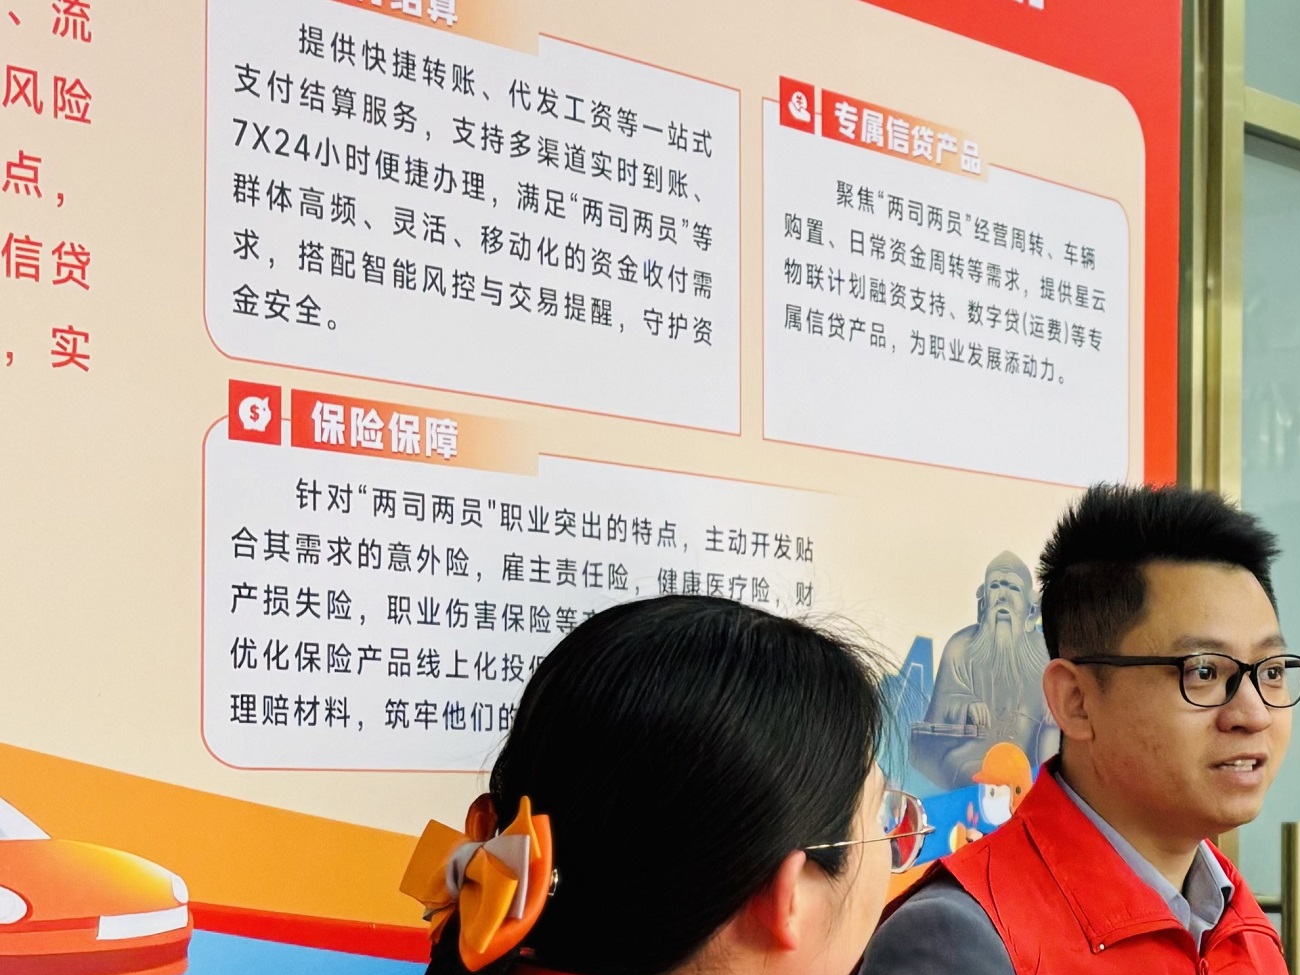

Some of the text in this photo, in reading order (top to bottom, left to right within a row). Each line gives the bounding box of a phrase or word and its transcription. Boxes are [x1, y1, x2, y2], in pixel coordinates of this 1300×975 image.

[2, 64, 92, 124] 风险
[298, 23, 713, 158] 提供快捷转账、代发工资等一站式
[233, 62, 704, 204] 支付结算服务，支持多渠道实时到账、
[834, 100, 982, 175] 专属信贷产品
[1, 232, 91, 291] 信贷
[231, 172, 713, 300] 群体高频、灵活、移动化的资金收付需
[783, 213, 1106, 313] 购置、日常资金周转等需求，提供星云
[231, 228, 713, 346] 求，搭配智能风控与交易提醒，守护资
[231, 283, 341, 332] 金安全。
[783, 303, 1065, 386] 属信贷产品，为职业发展添动力。
[310, 400, 459, 459] 保险保障
[230, 581, 596, 637] 产损失险，职业伤害保险等
